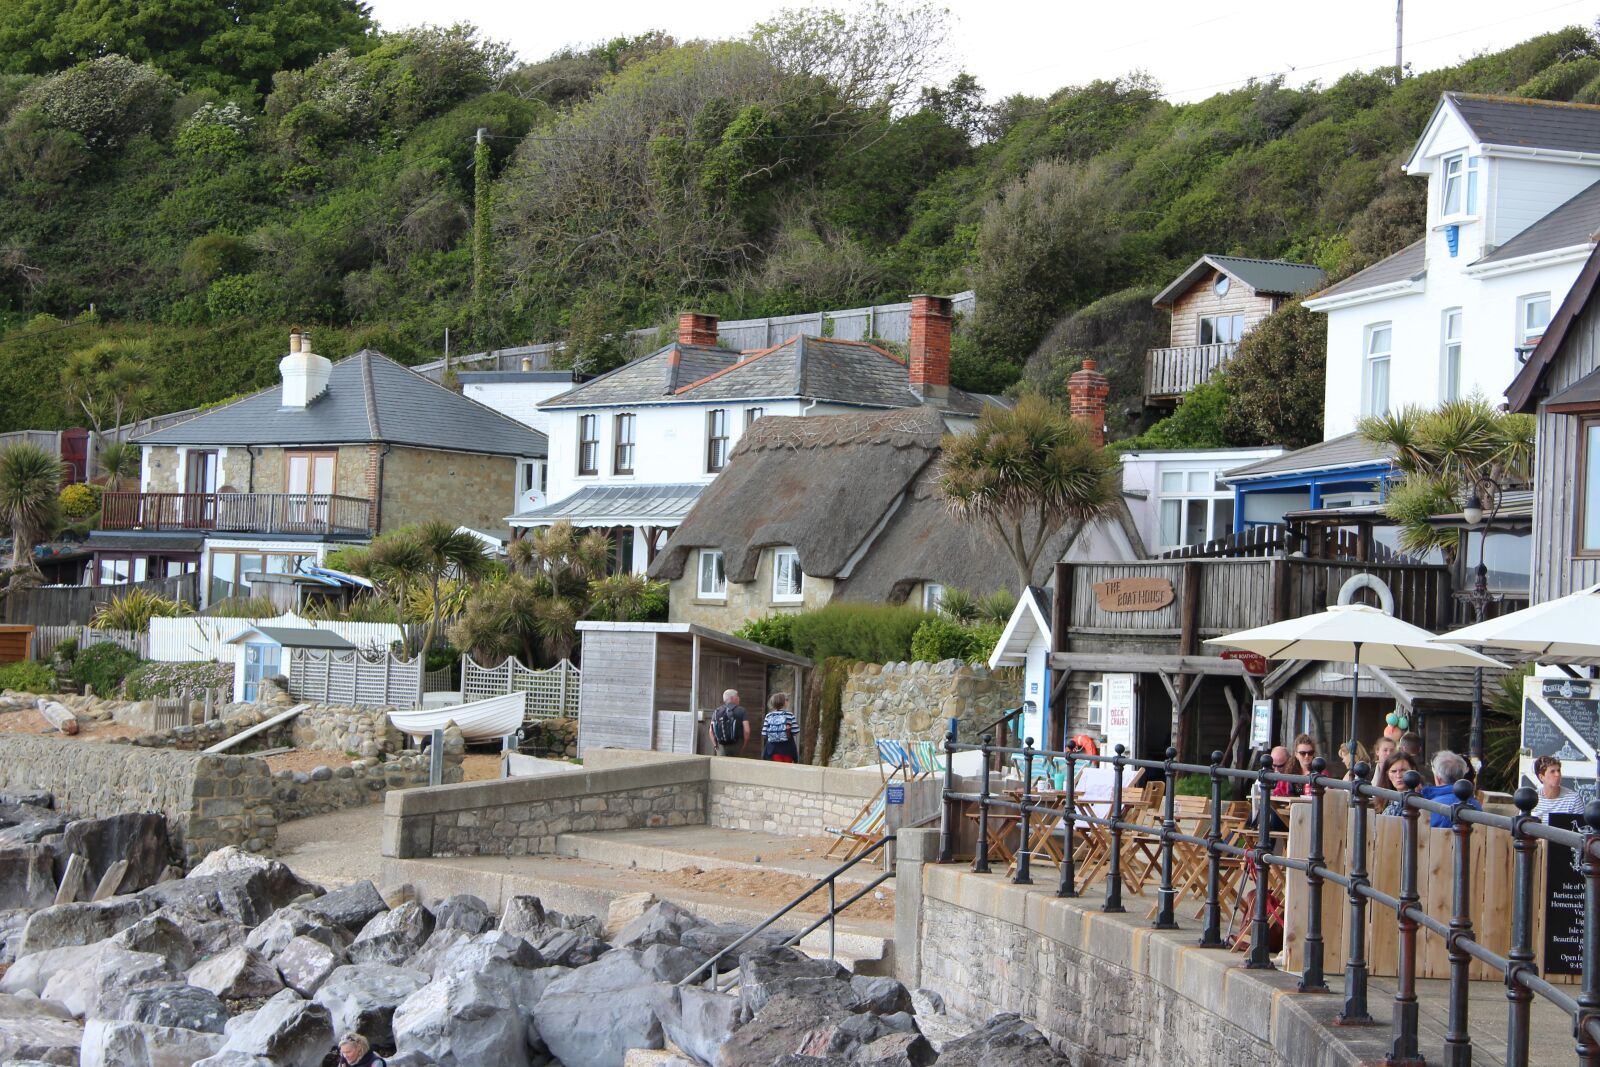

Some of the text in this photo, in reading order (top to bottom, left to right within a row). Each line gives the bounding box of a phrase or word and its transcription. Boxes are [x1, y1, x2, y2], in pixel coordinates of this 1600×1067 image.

[1105, 582, 1120, 596] THE
[1117, 590, 1165, 606] BOATHOUSE
[1560, 954, 1576, 962] Open
